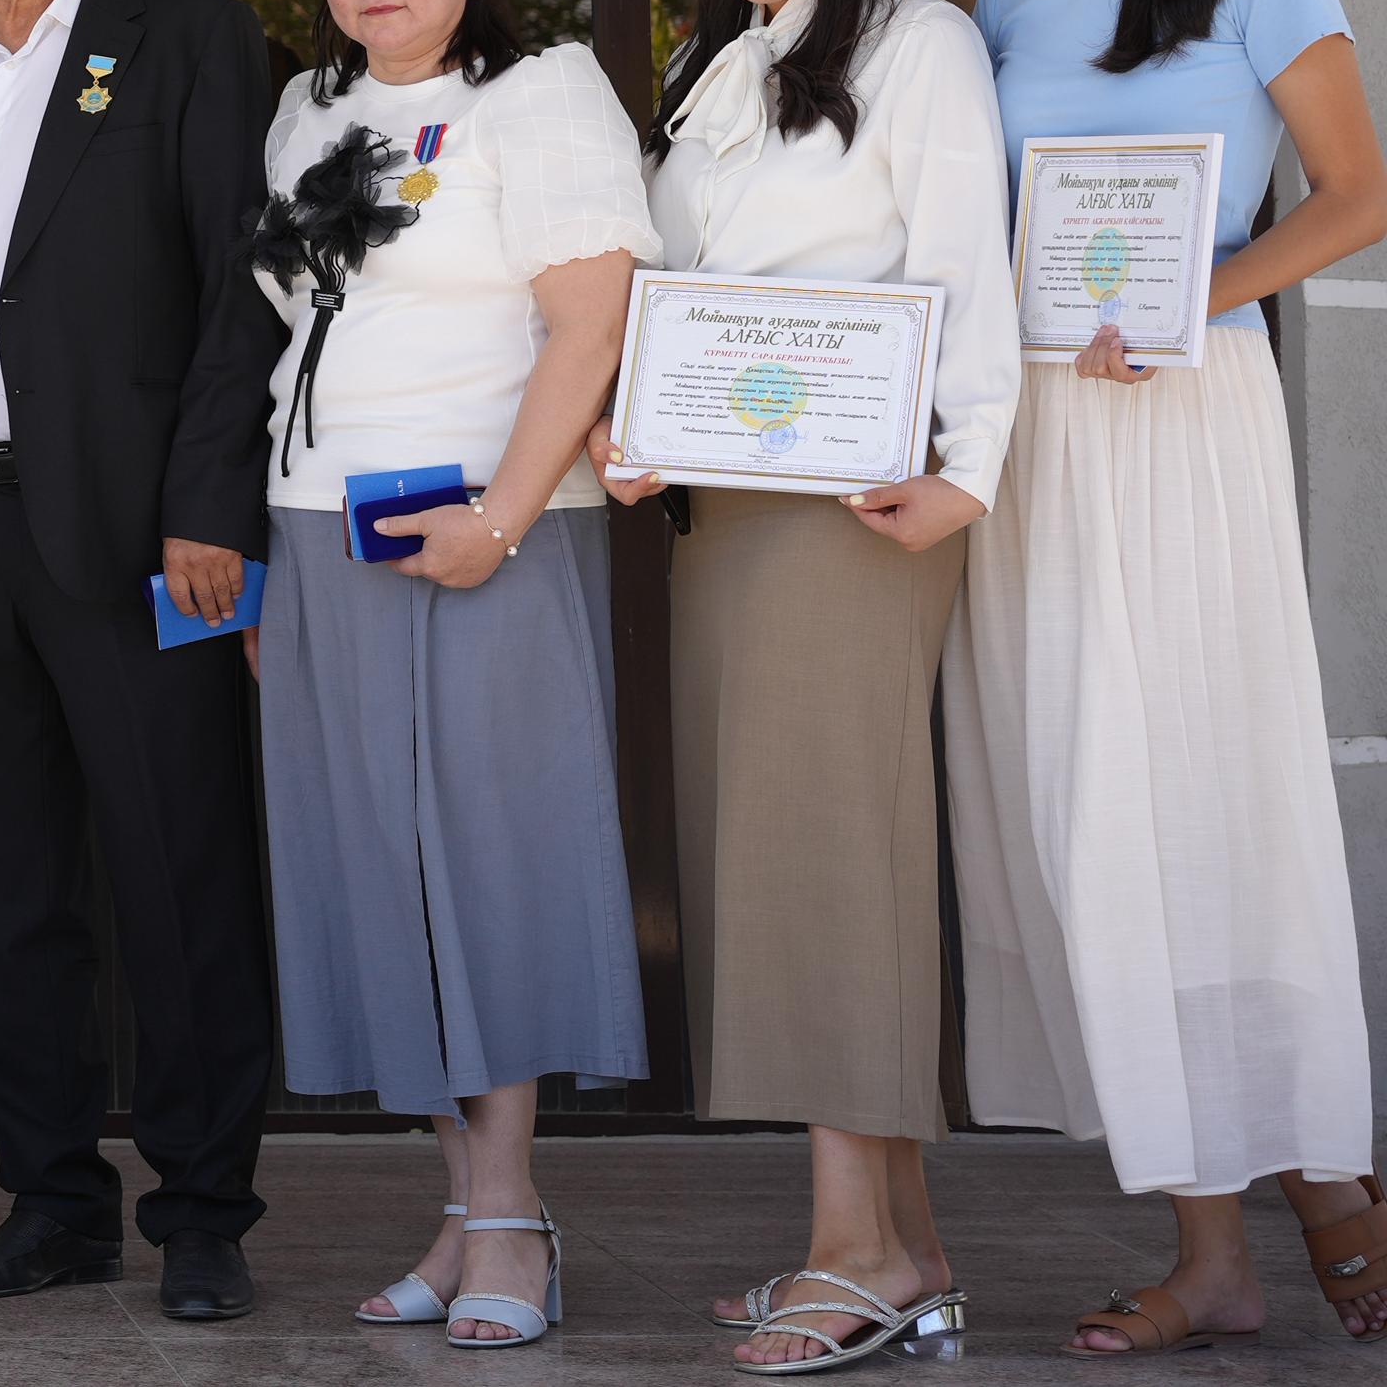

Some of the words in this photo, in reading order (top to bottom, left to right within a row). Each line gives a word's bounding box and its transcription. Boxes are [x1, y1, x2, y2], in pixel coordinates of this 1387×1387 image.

[1077, 194, 1116, 209] АЛҒЫС
[1119, 193, 1155, 209] ХАТЫ
[769, 316, 820, 329] ауданы
[826, 318, 881, 333] әкімінің
[718, 329, 784, 346] АЛҒЫС
[787, 332, 844, 349] ХАТЫ
